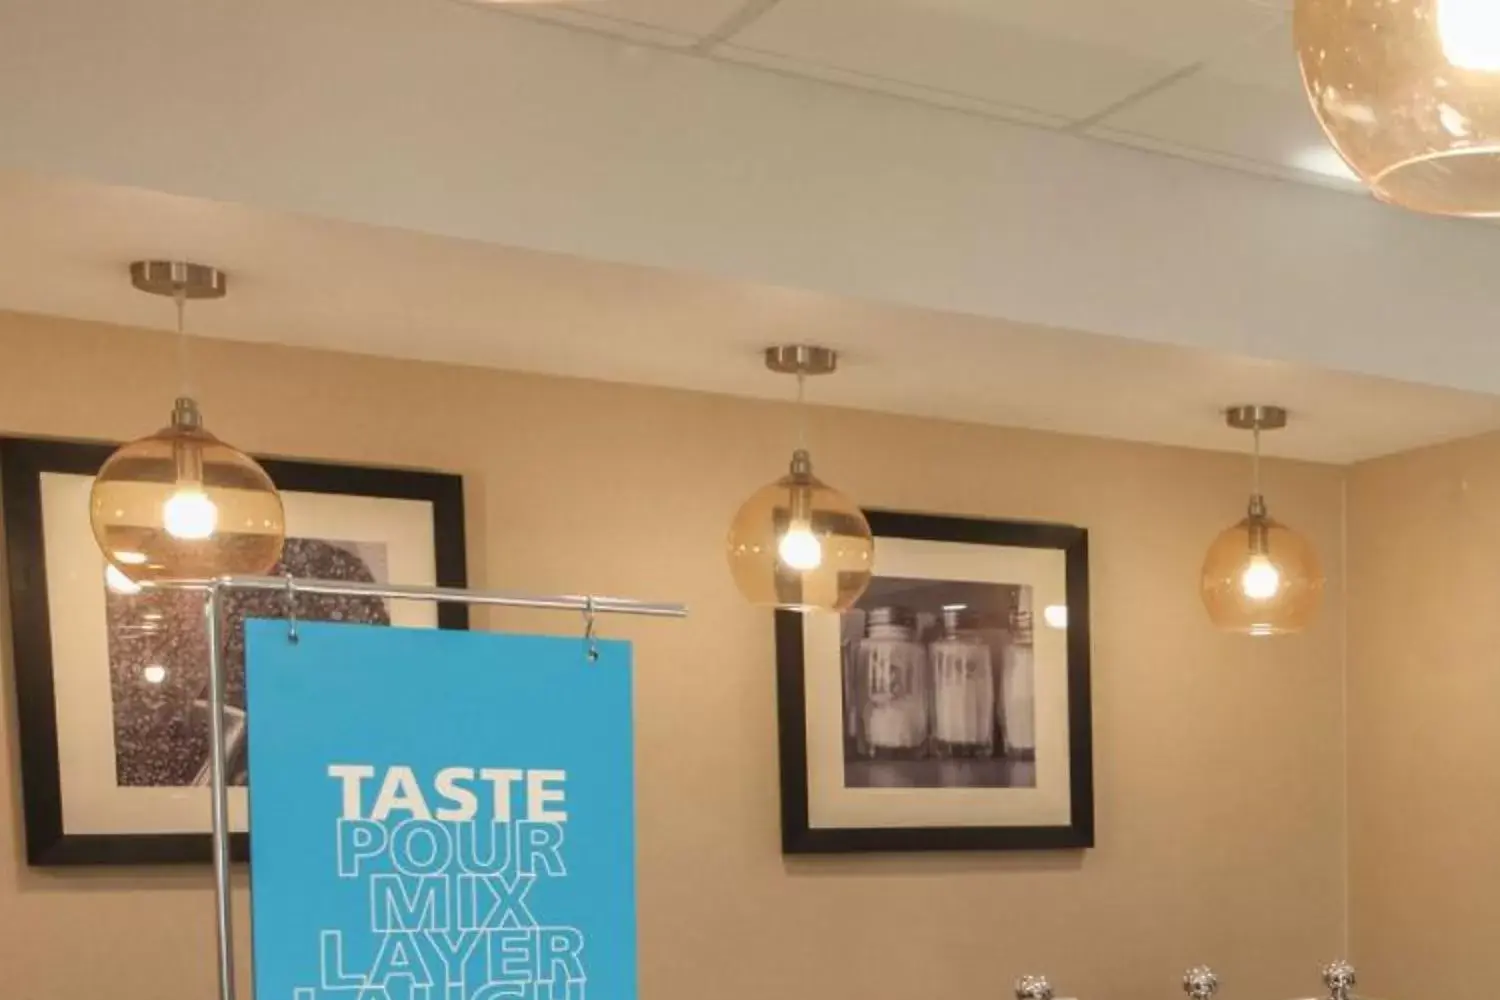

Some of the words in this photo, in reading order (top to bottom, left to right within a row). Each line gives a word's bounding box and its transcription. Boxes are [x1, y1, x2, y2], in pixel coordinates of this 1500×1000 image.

[327, 765, 568, 822] TASTE
[336, 818, 567, 877] POUR
[370, 873, 537, 932] MIX
[320, 926, 587, 990] LAYER
